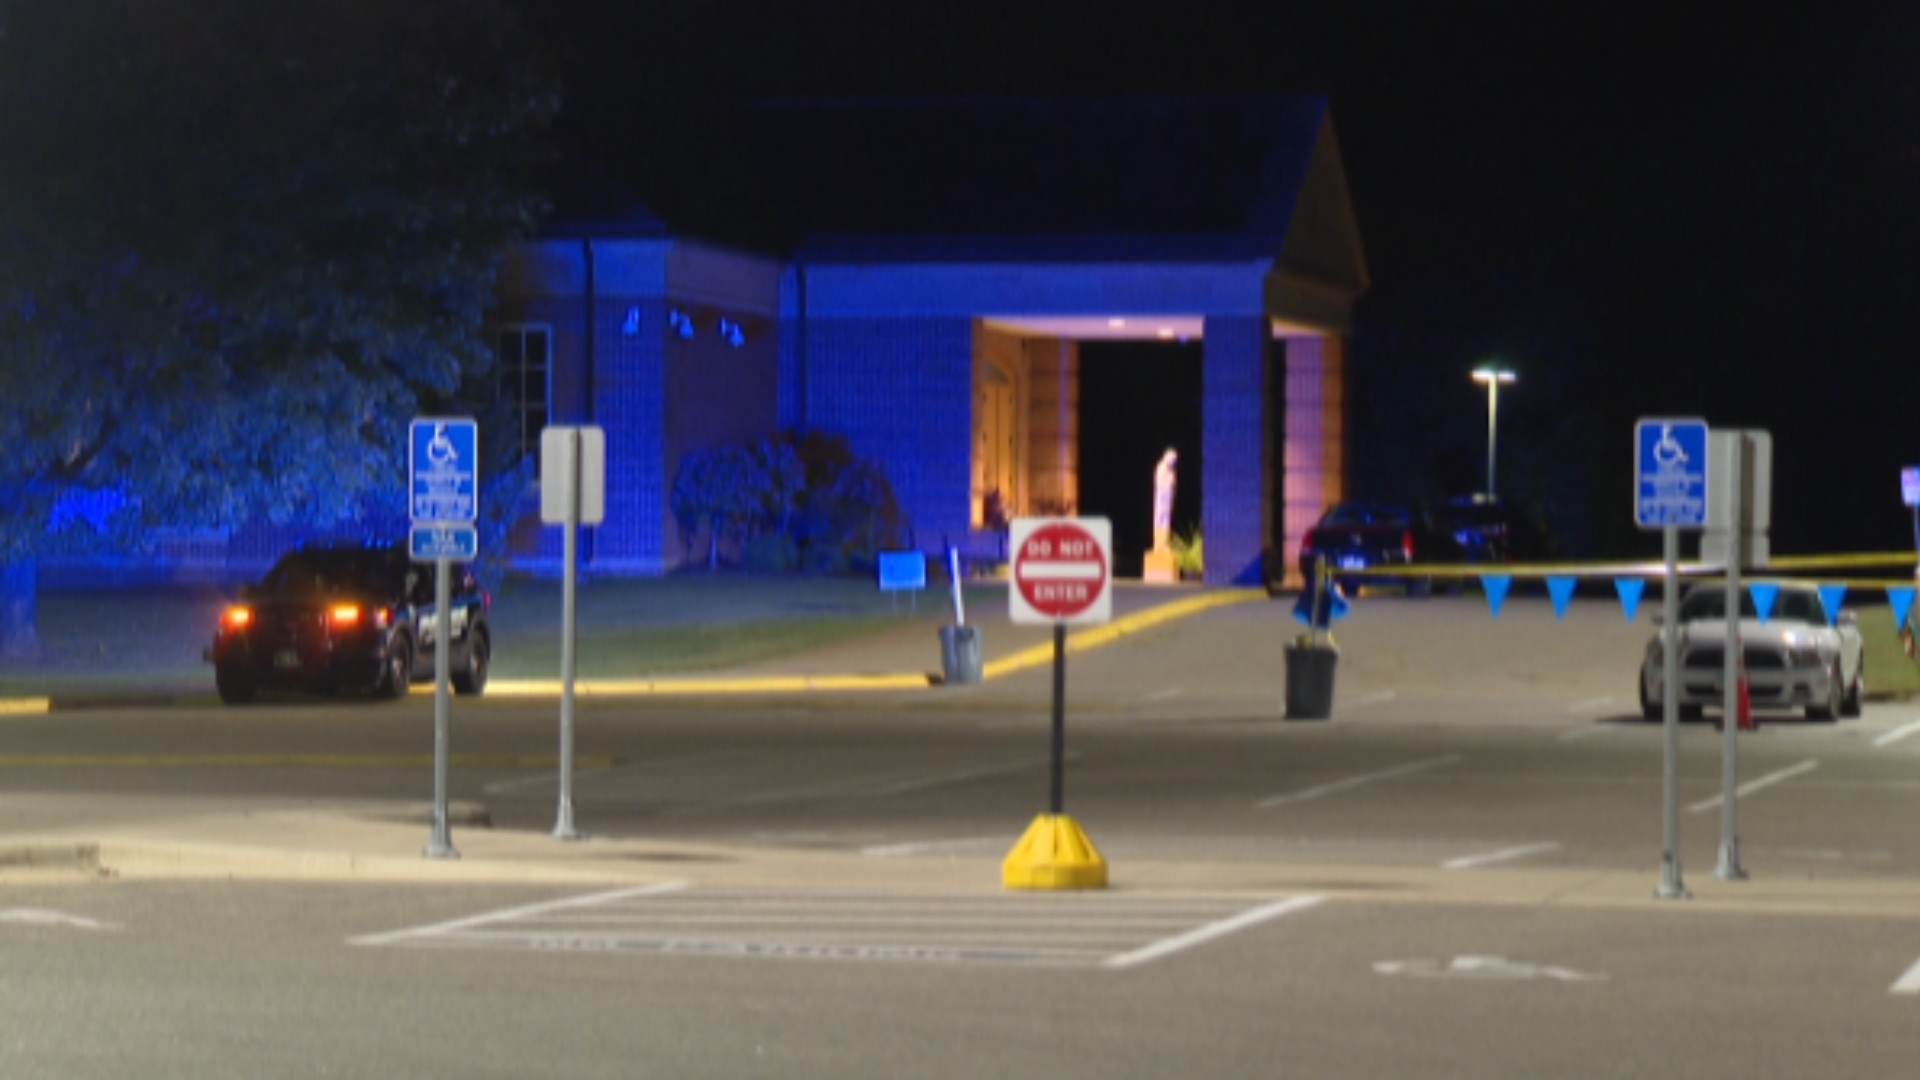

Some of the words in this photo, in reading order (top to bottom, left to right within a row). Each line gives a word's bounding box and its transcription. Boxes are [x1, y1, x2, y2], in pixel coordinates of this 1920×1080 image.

[1026, 539, 1052, 556] DO
[1059, 539, 1094, 556] NOT
[1034, 582, 1088, 602] ENTER
